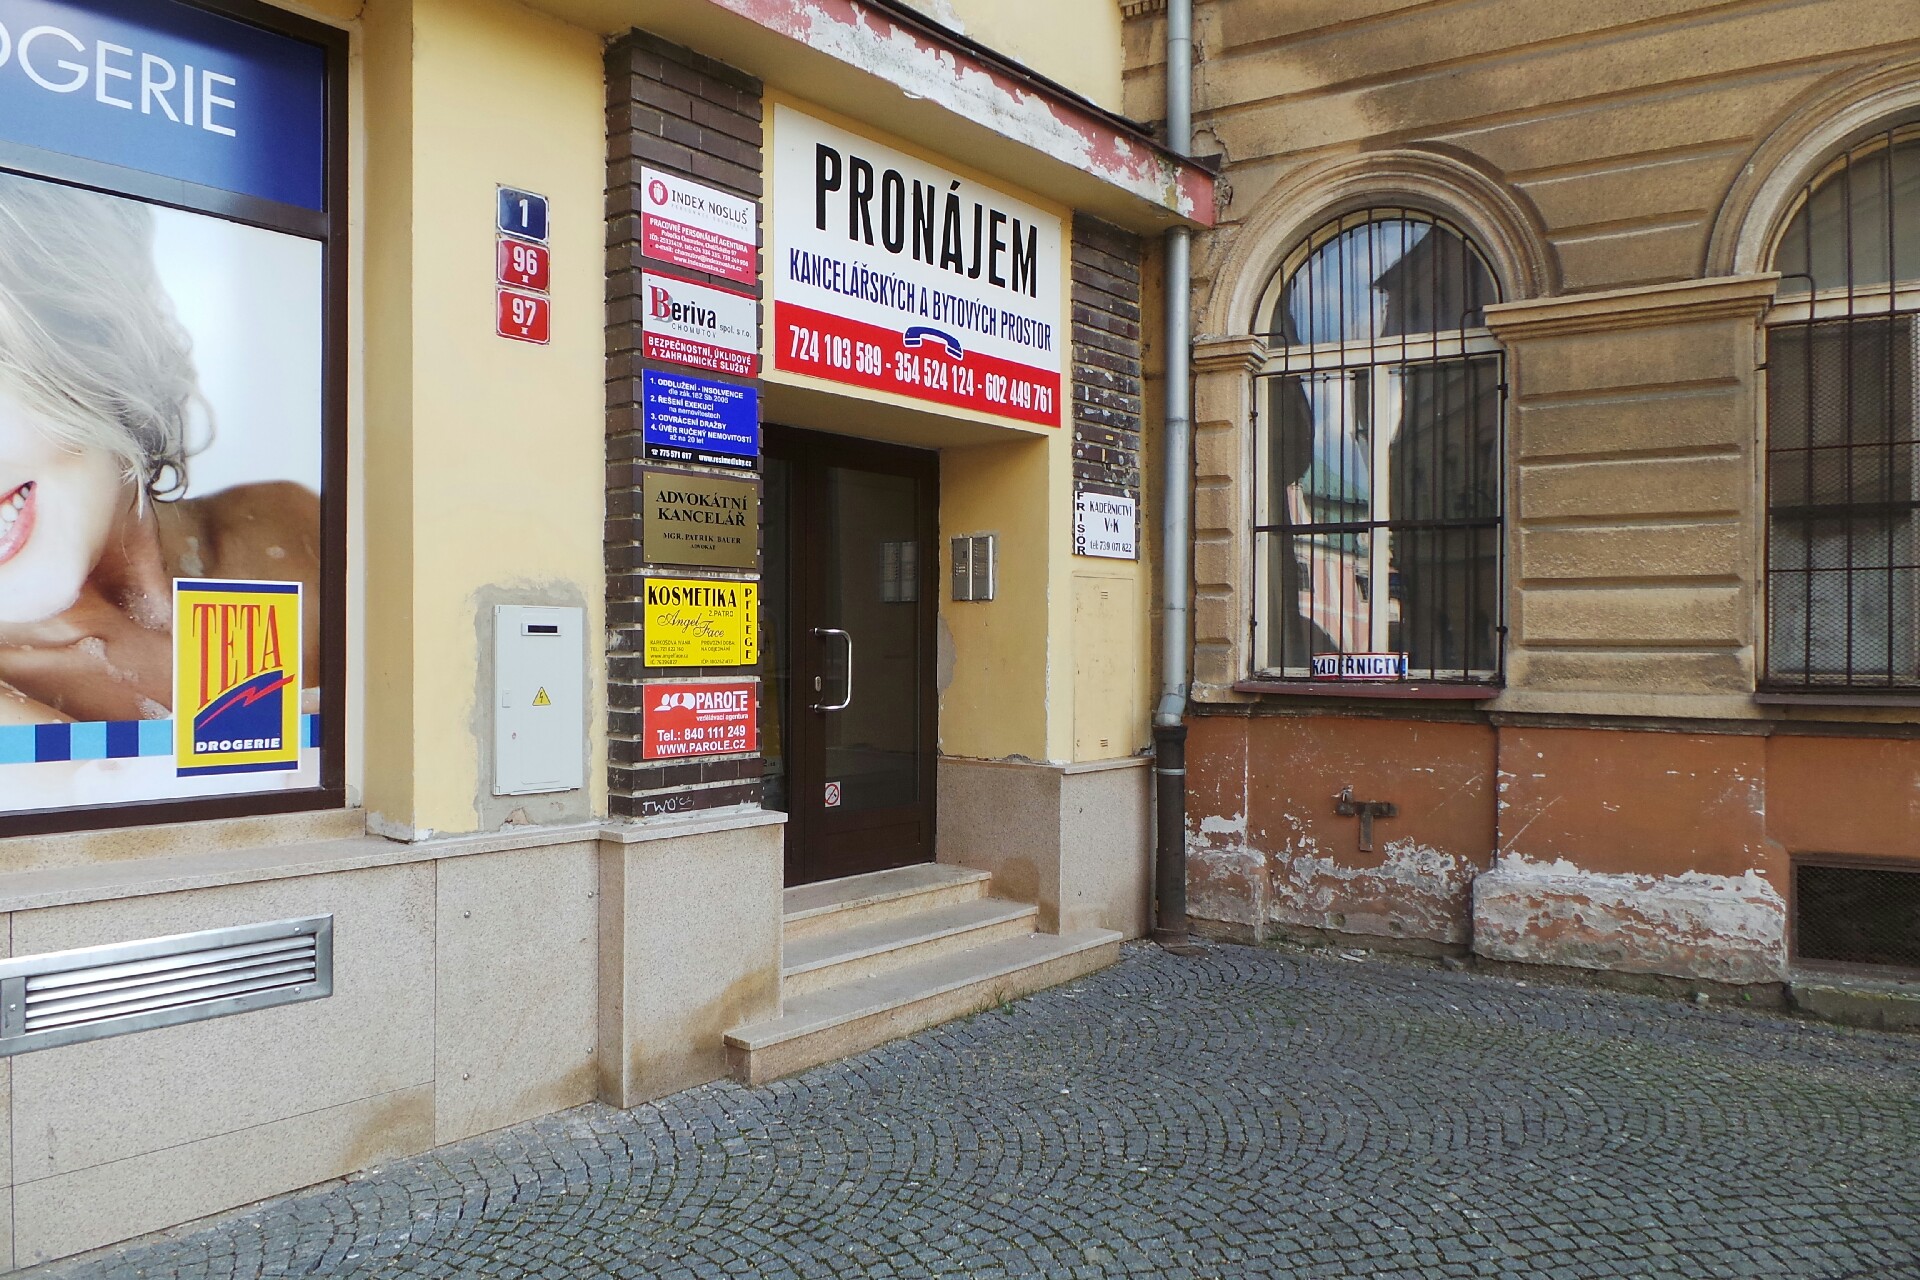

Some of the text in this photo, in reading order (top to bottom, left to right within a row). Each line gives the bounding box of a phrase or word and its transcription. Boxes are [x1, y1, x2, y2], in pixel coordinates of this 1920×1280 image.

[0, 20, 236, 137] GERIE
[519, 198, 528, 228] 1
[672, 189, 748, 225] INDEX NOSLUŠ
[815, 142, 1037, 299] PRONÁJEM
[719, 238, 749, 254] AGENTURA
[513, 246, 537, 276] 96
[648, 285, 717, 329] Beriva
[790, 247, 1051, 352] KANCELÁŘSKÝCH A BYTOVÝCH PROSTOR
[512, 297, 536, 327] 97
[671, 322, 717, 338] CHOMUTOV
[648, 336, 751, 366] BEZPEČNOSTNÍ, ÚKLIDOVÉ
[651, 347, 749, 374] A ZAHRADNICKÉ SLUŽBY
[789, 325, 819, 363] 724
[824, 334, 851, 370] 103
[855, 342, 882, 376] 589
[895, 354, 920, 386] 354
[923, 361, 948, 392] 524
[952, 366, 974, 397] 124
[985, 373, 1007, 404] 602
[1010, 378, 1031, 409] 449
[1033, 382, 1052, 414] 761
[650, 377, 657, 385] 1.
[657, 377, 697, 391] ODDLUŽENÍ
[701, 385, 744, 399] INSOLVENCE
[650, 394, 714, 411] 2. ŘEŠENÍ EXEKUCÍ
[650, 421, 752, 444] 4. ÚVĚR RUČENÝ NEMOVITOSTÍ
[658, 413, 699, 426] ODVRÁCENÍ
[699, 418, 727, 430] DRAŽBY
[687, 435, 696, 443] 20
[656, 490, 748, 511] ADVOKÁTNÍ
[1089, 500, 1132, 517] KADEŘNICTVÍ
[657, 507, 747, 527] KANCELÁŘ
[663, 532, 741, 544] MGR. PATRIK BAUER
[648, 585, 737, 608] KOSMETIKA
[656, 609, 702, 634] Angel
[692, 620, 725, 638] Face
[192, 604, 283, 711] TETA
[696, 690, 748, 713] PAROLE
[195, 737, 280, 752] DROGERIE
[657, 725, 746, 742] Tel.: 840 111 249
[656, 739, 746, 755] WWW.PAROLE.CZ
